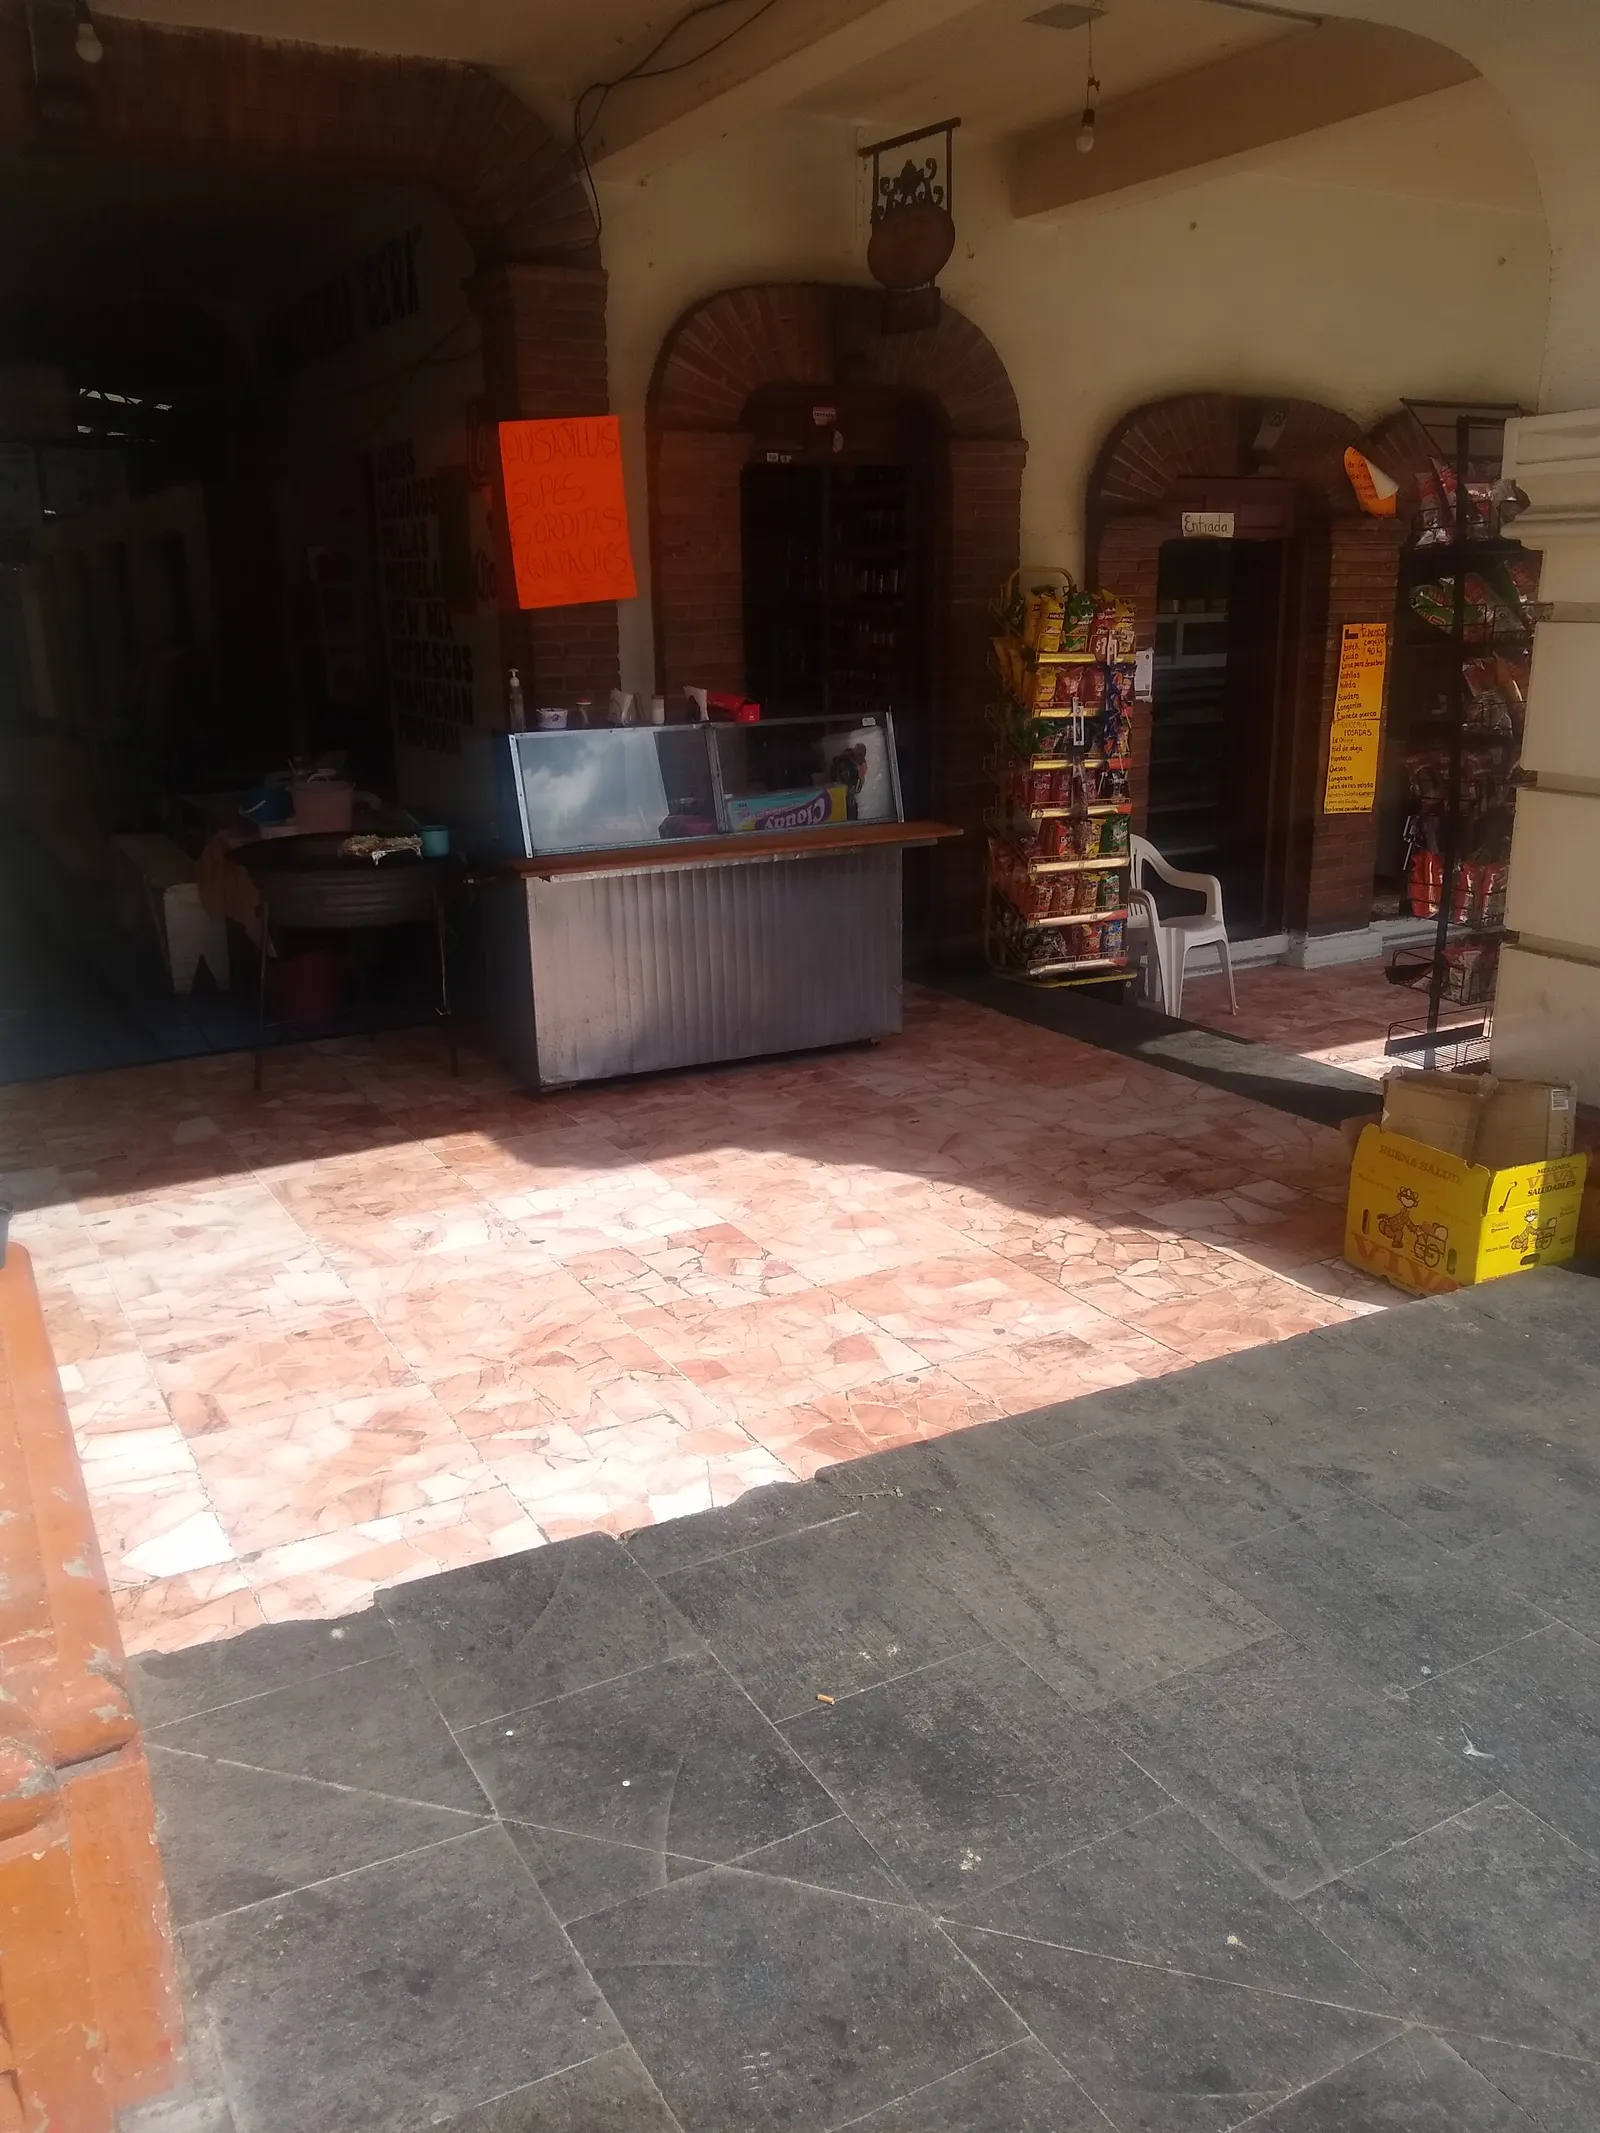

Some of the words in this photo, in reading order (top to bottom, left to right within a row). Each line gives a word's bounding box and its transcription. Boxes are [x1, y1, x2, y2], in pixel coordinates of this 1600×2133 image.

[511, 508, 622, 545] GORDITAS
[1184, 514, 1229, 533] Entrada
[1379, 1144, 1417, 1167] BUENA
[1420, 1161, 1461, 1185] SALUD
[1536, 1163, 1571, 1175] MELONES
[1526, 1169, 1577, 1189] VIVA
[1527, 1180, 1576, 1197] SALUDABLES
